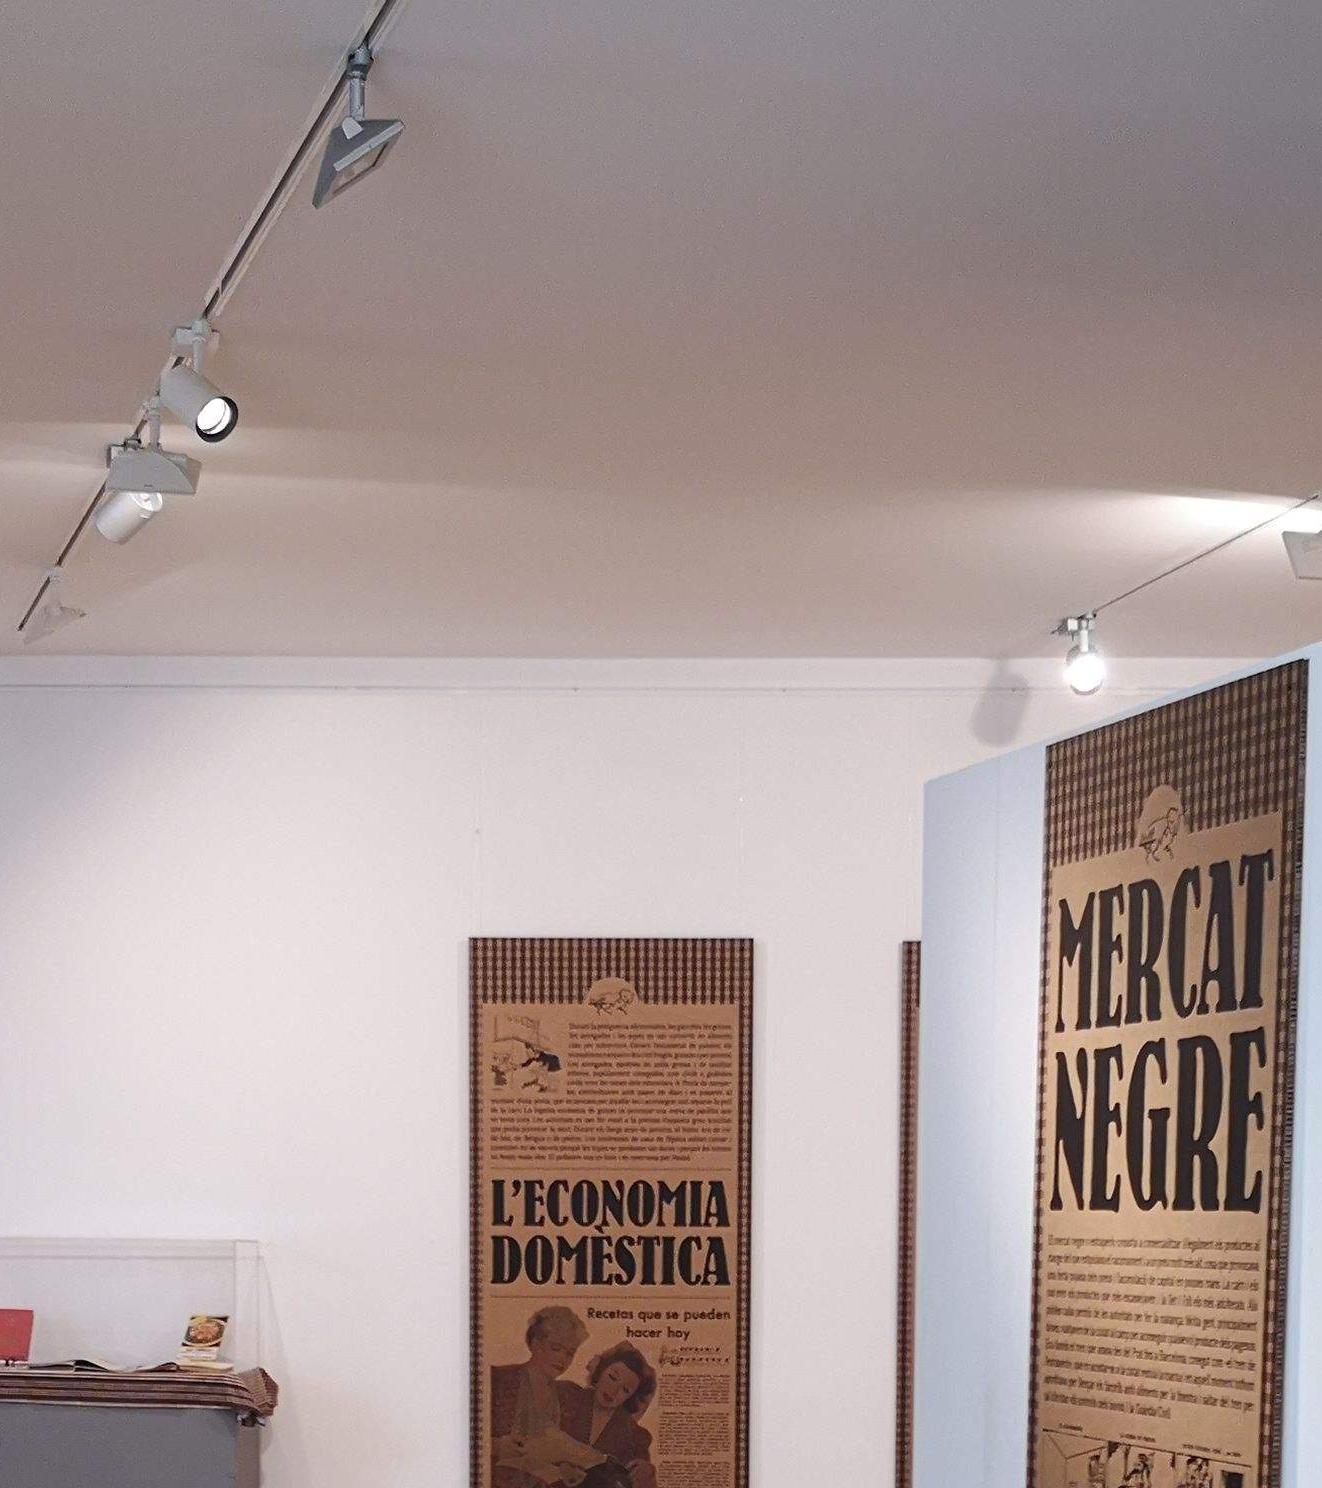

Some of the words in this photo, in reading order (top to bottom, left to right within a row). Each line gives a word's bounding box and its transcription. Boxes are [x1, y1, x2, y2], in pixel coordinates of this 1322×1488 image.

[1055, 853, 1275, 1033] MERCAT
[1050, 1026, 1267, 1214] NEGRE
[491, 1179, 731, 1228] L'ECONOMIA
[490, 1225, 731, 1286] DOMÈSTICA
[587, 1307, 634, 1320] Recetas
[638, 1310, 661, 1323] que
[666, 1310, 678, 1320] se
[684, 1308, 731, 1322] pueden
[626, 1326, 662, 1338] hacer
[667, 1326, 690, 1340] hoy
